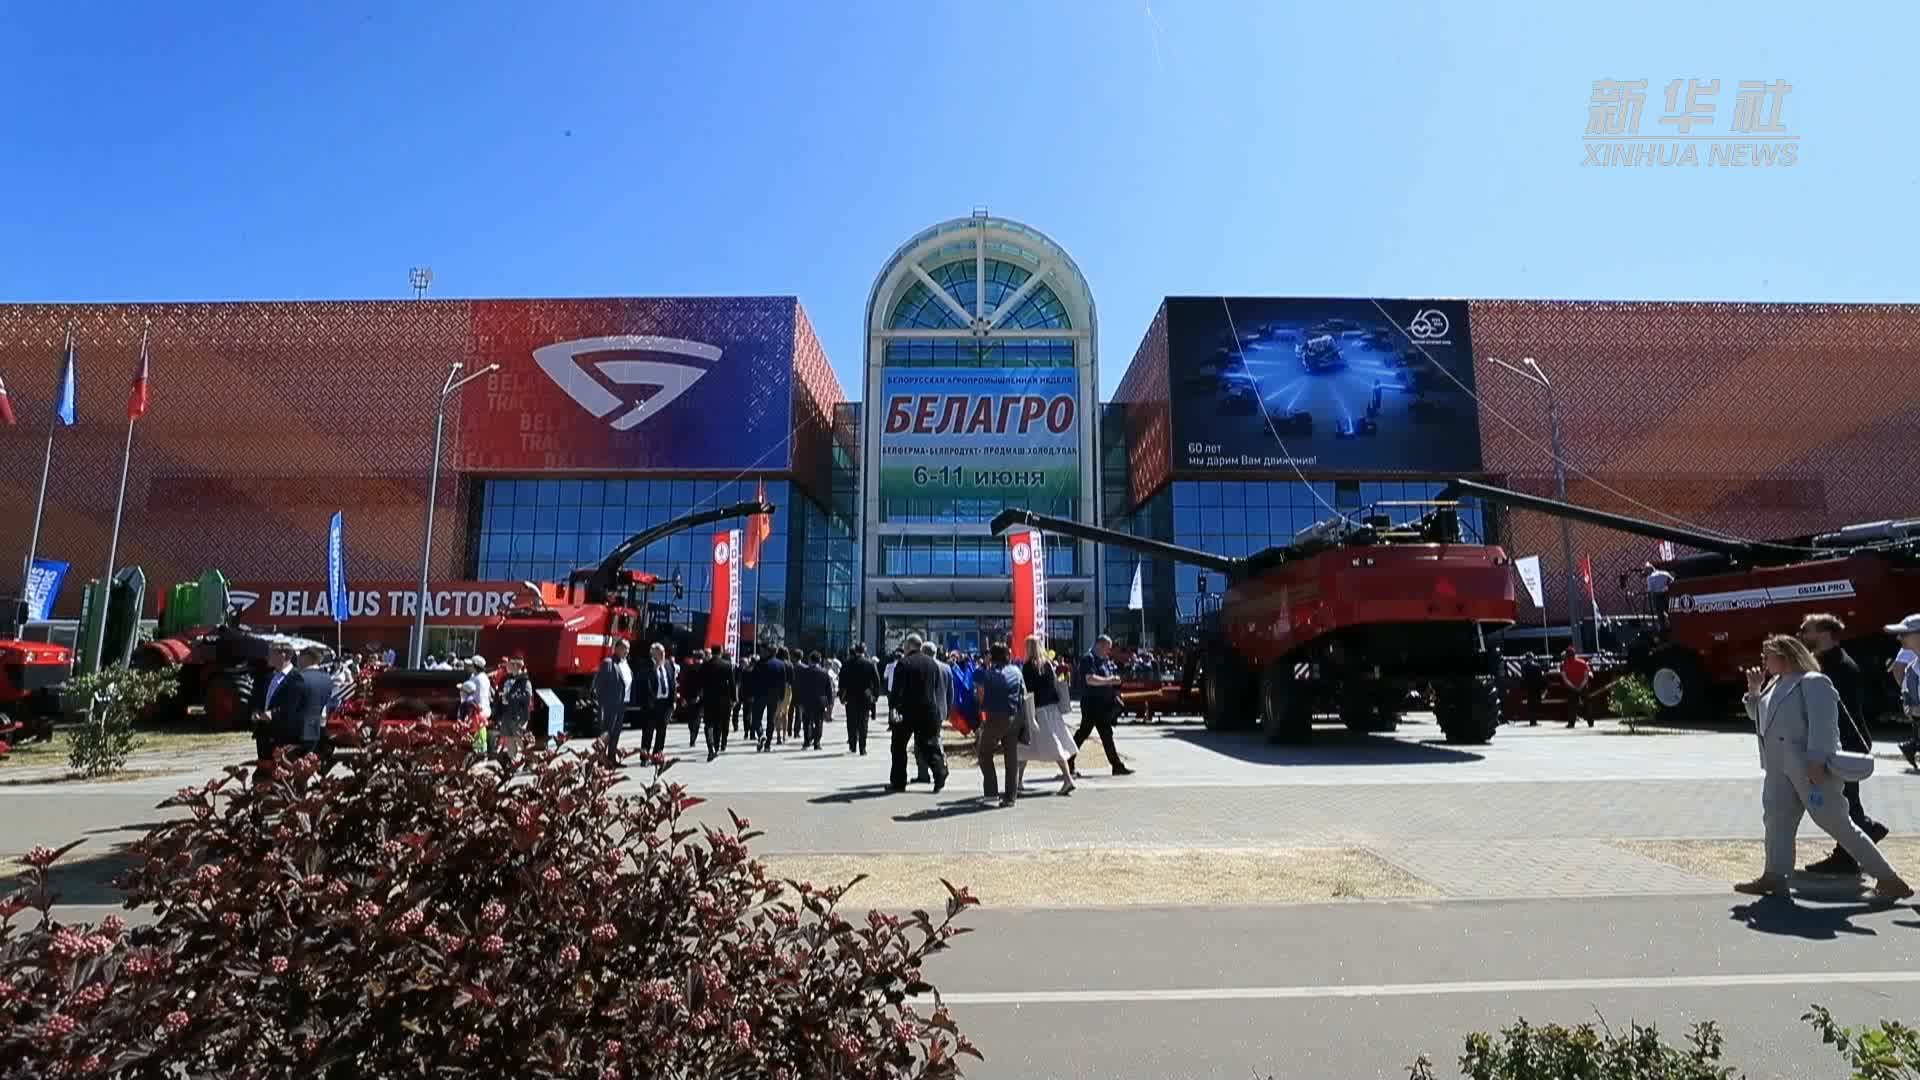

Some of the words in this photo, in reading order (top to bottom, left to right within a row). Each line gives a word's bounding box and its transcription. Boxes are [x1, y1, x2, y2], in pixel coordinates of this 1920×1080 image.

[886, 376, 945, 385] БЕЛОРУССКАЯ
[947, 376, 1038, 385] АГРОПРОМЫШЛЕННАЯ
[1040, 376, 1073, 385] НЕДЕЛЯ
[884, 395, 1075, 435] БЕЛАГРО
[1188, 443, 1203, 454] 60
[1204, 444, 1222, 454] лет
[1189, 456, 1204, 465] мы
[1206, 456, 1239, 467] дарим
[1241, 455, 1261, 465] Вам
[1263, 455, 1317, 467] движение!
[914, 465, 963, 486] 6-11
[974, 470, 1046, 486] июня
[1827, 583, 1846, 592] PRO
[270, 591, 381, 617] BELAUS
